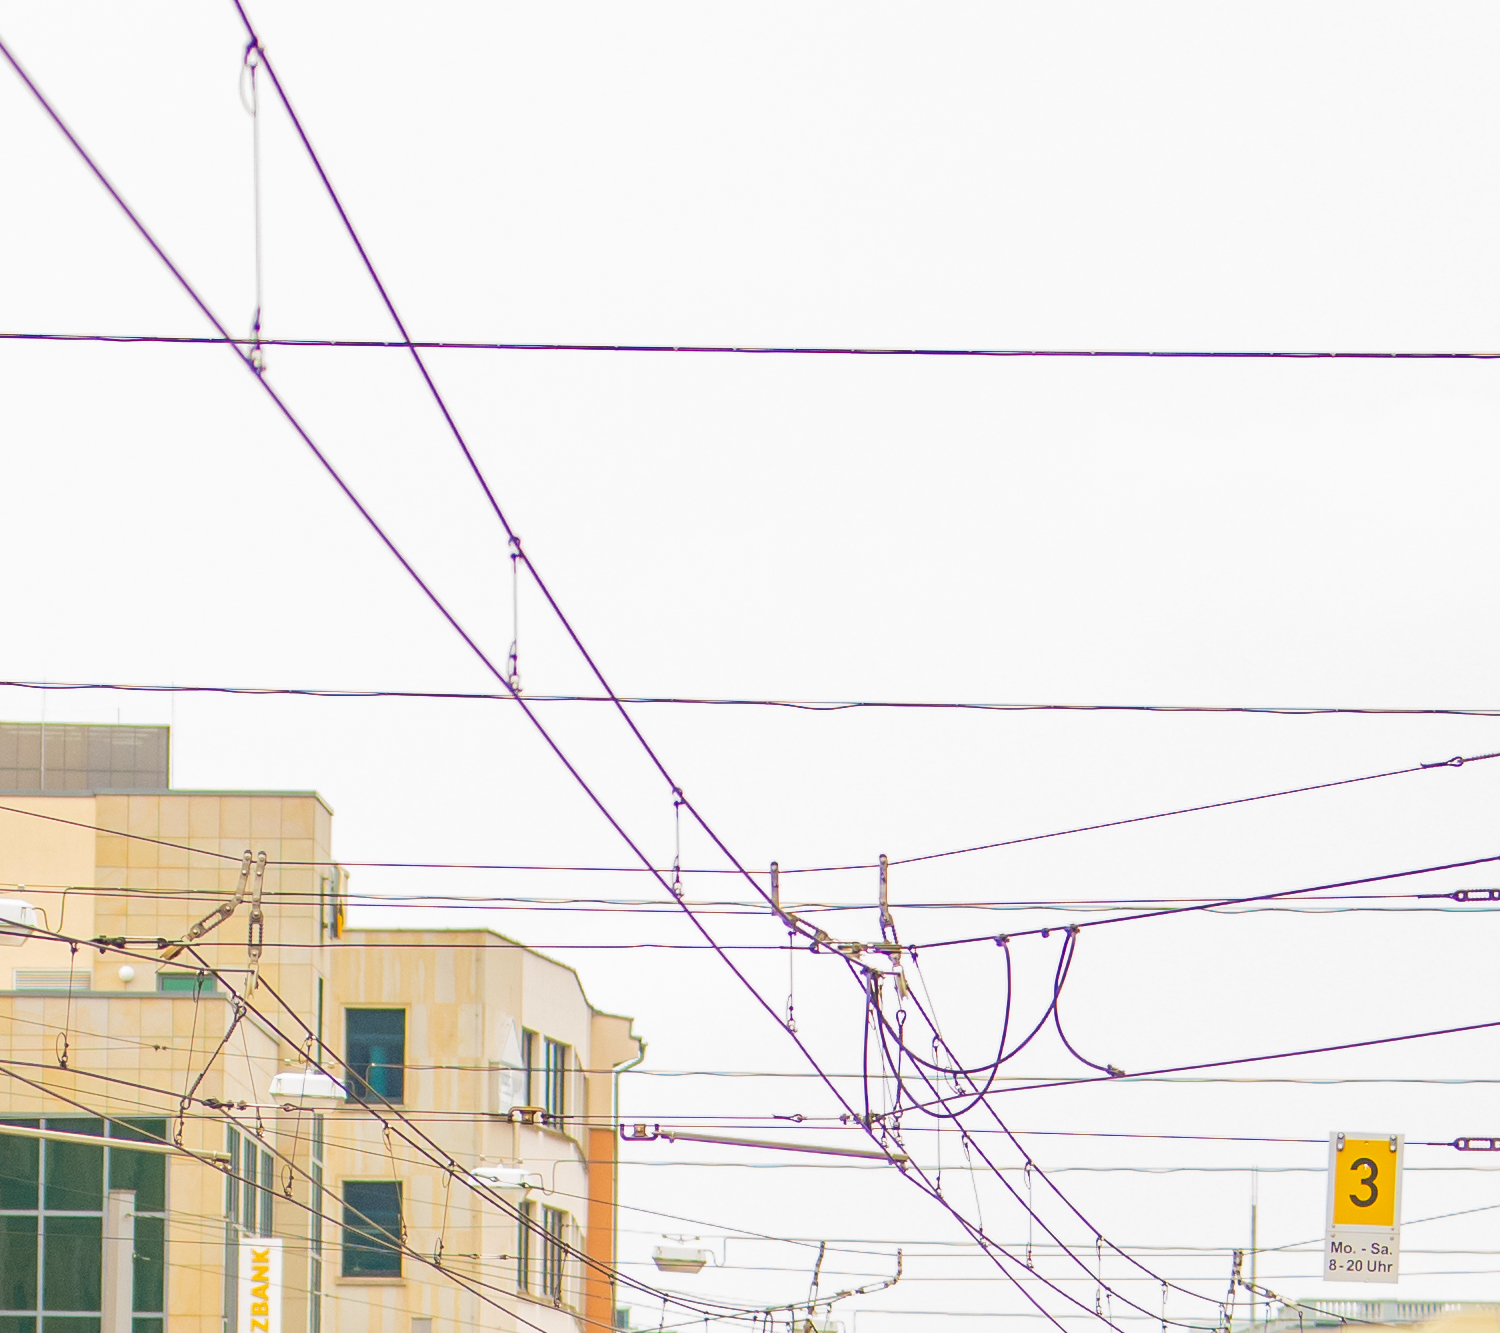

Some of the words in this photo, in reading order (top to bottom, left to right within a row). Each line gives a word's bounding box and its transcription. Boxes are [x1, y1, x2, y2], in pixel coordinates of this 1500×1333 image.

[1349, 1157, 1379, 1208] 3
[1330, 1241, 1357, 1255] Mo.
[1370, 1243, 1393, 1256] Sa.
[1367, 1260, 1393, 1273] Uhr
